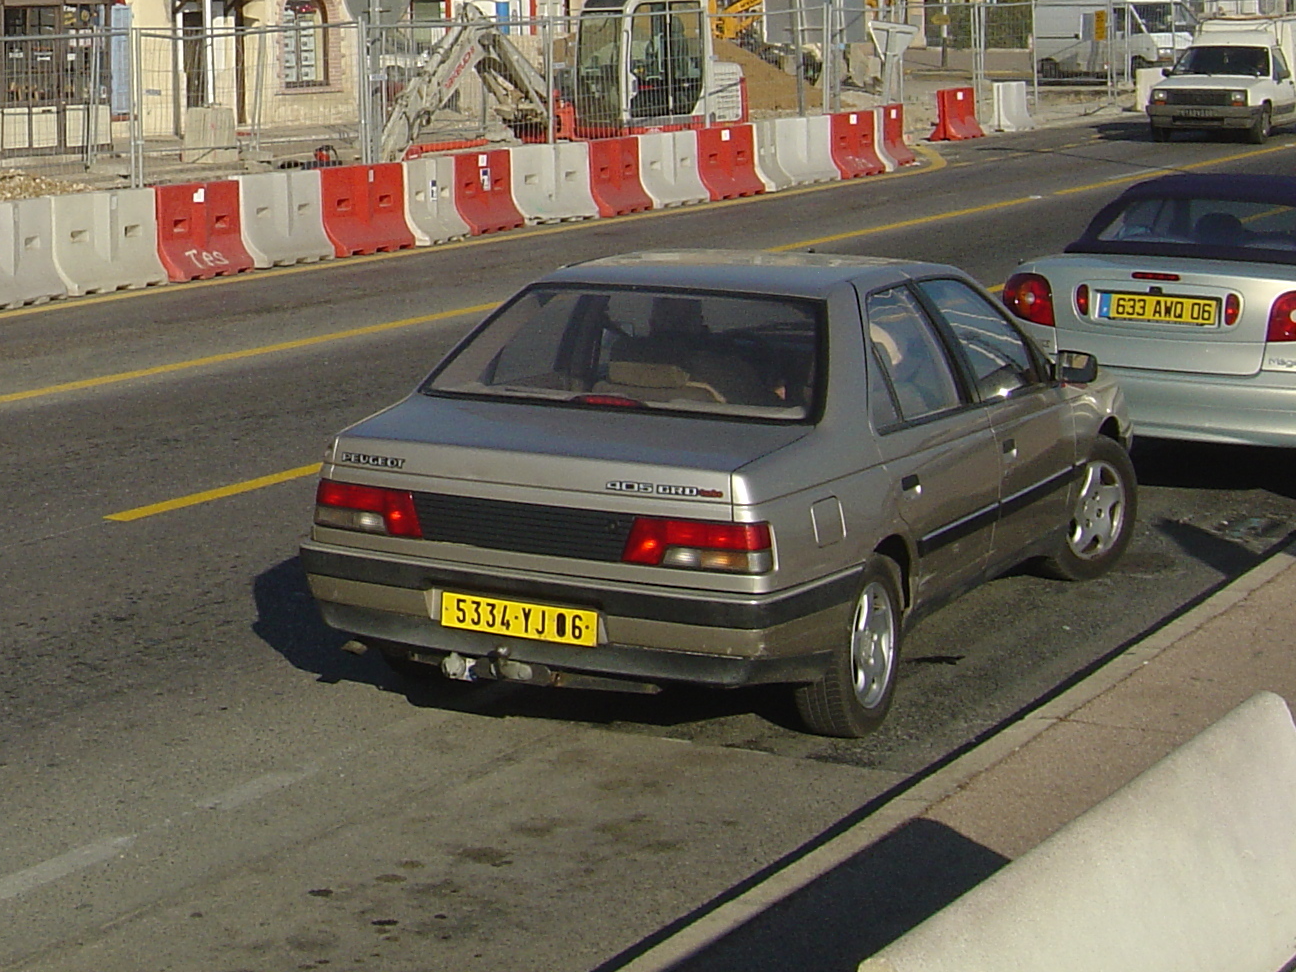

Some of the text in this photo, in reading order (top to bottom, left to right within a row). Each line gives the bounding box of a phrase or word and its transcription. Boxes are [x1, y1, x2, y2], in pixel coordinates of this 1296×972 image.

[1116, 297, 1212, 322] 633 AWQ 06
[342, 452, 405, 469] PEUGEOT
[605, 480, 653, 494] 405
[656, 484, 698, 497] GRD
[456, 598, 583, 639] 5334 YJ 06
